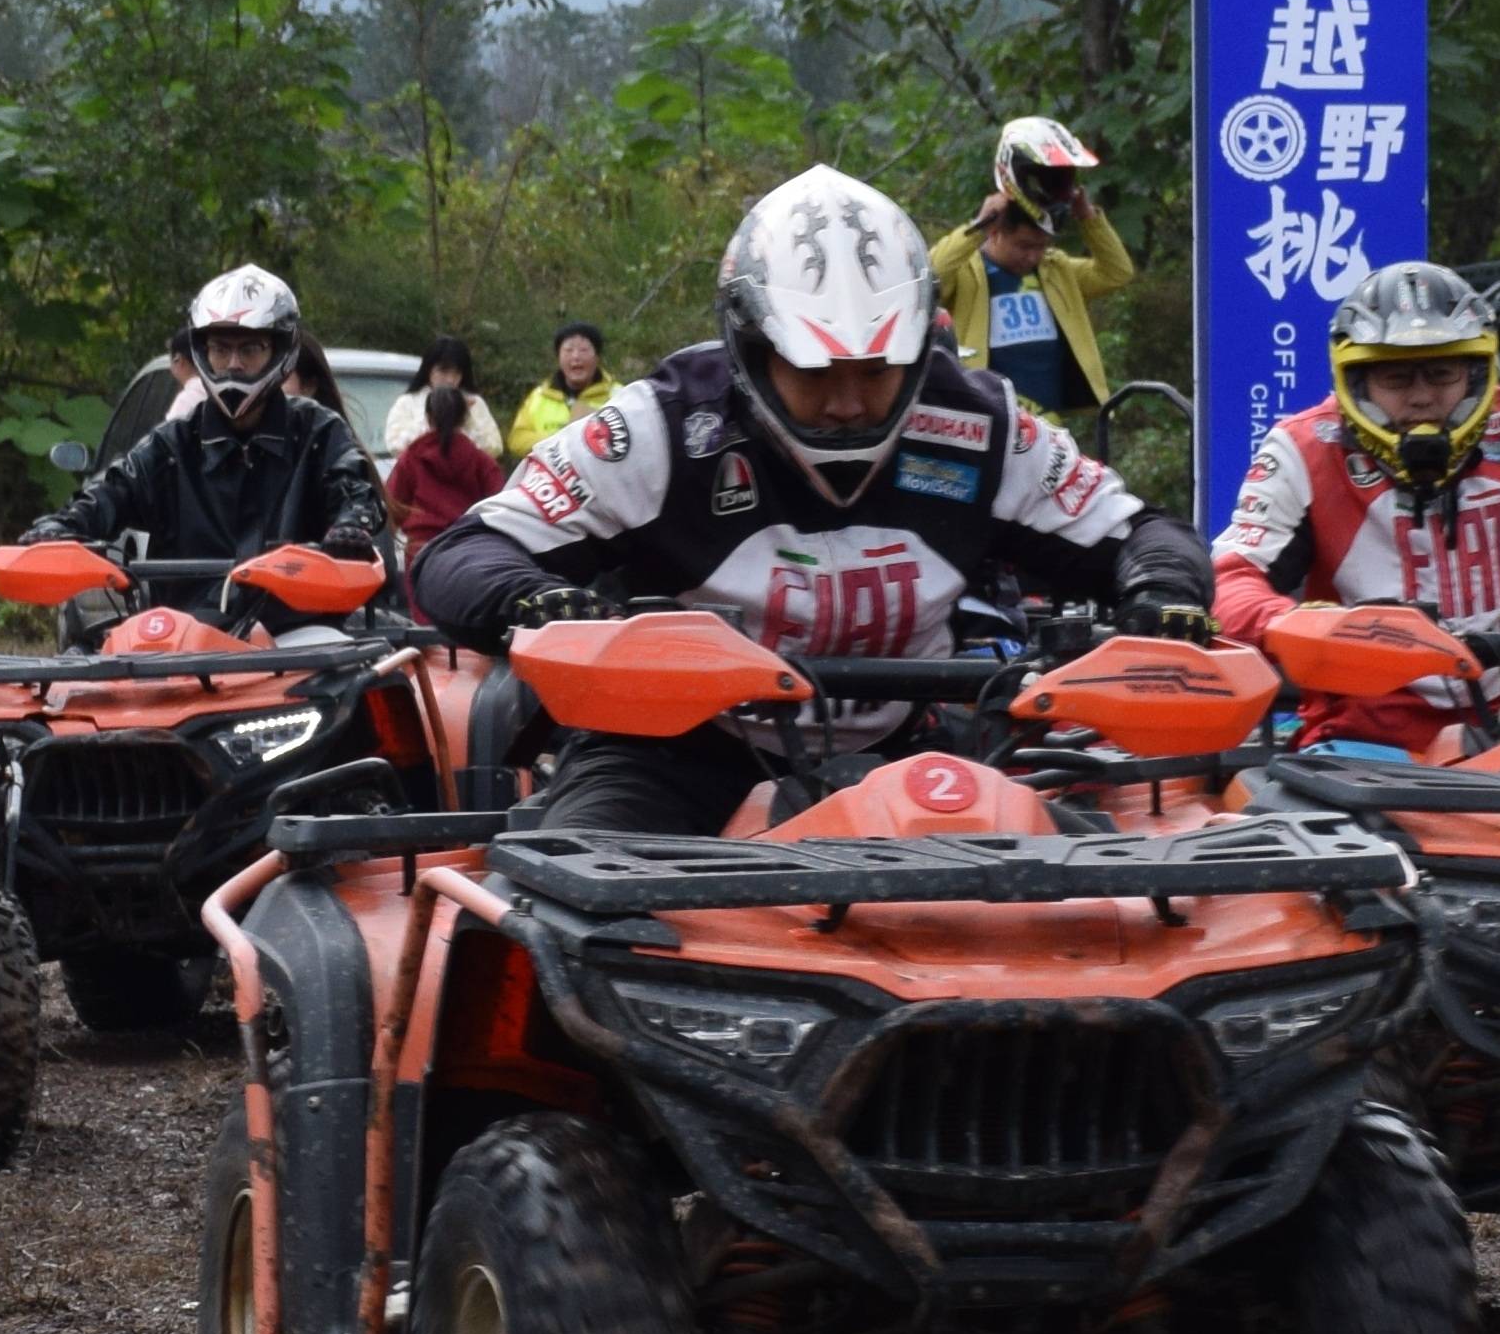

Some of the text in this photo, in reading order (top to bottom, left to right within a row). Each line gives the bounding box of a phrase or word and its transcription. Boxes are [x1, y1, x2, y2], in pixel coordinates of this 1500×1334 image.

[998, 294, 1041, 330] 39
[1273, 322, 1297, 420] OFF-
[147, 616, 165, 635] 5
[760, 561, 922, 657] FIAT
[925, 767, 964, 801] 2
